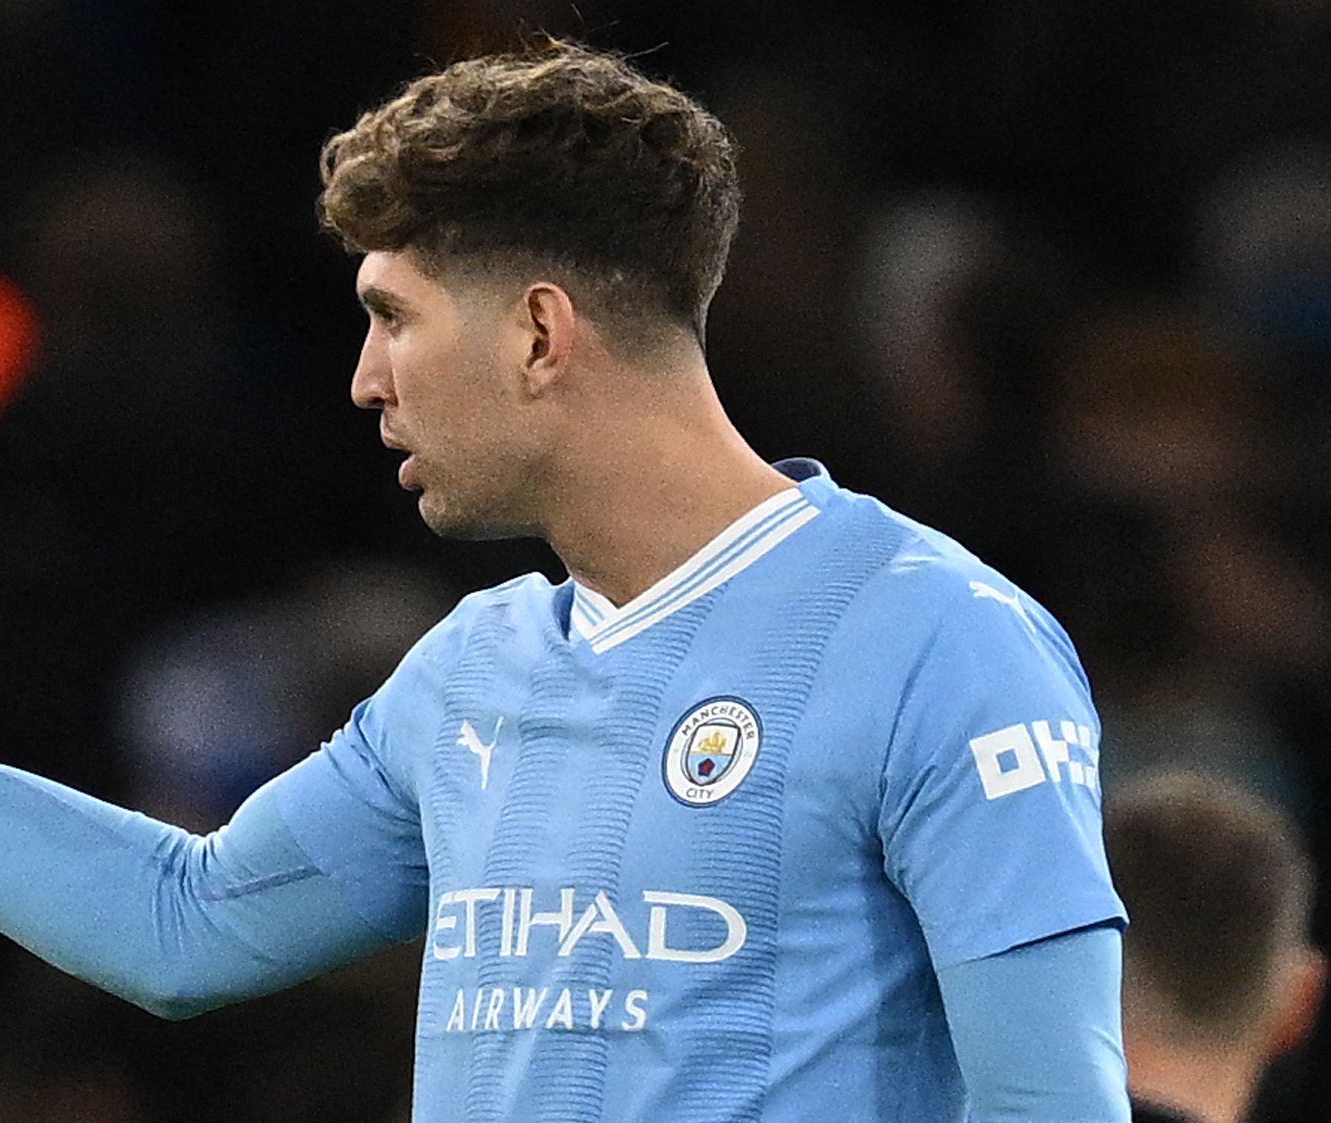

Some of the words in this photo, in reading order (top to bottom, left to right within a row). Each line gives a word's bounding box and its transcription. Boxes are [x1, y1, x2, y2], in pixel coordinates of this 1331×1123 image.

[681, 705, 756, 740] MANCHESTER
[685, 787, 715, 799] CITY
[433, 888, 747, 963] ETIHAD
[446, 987, 649, 1032] AIRWAYS
